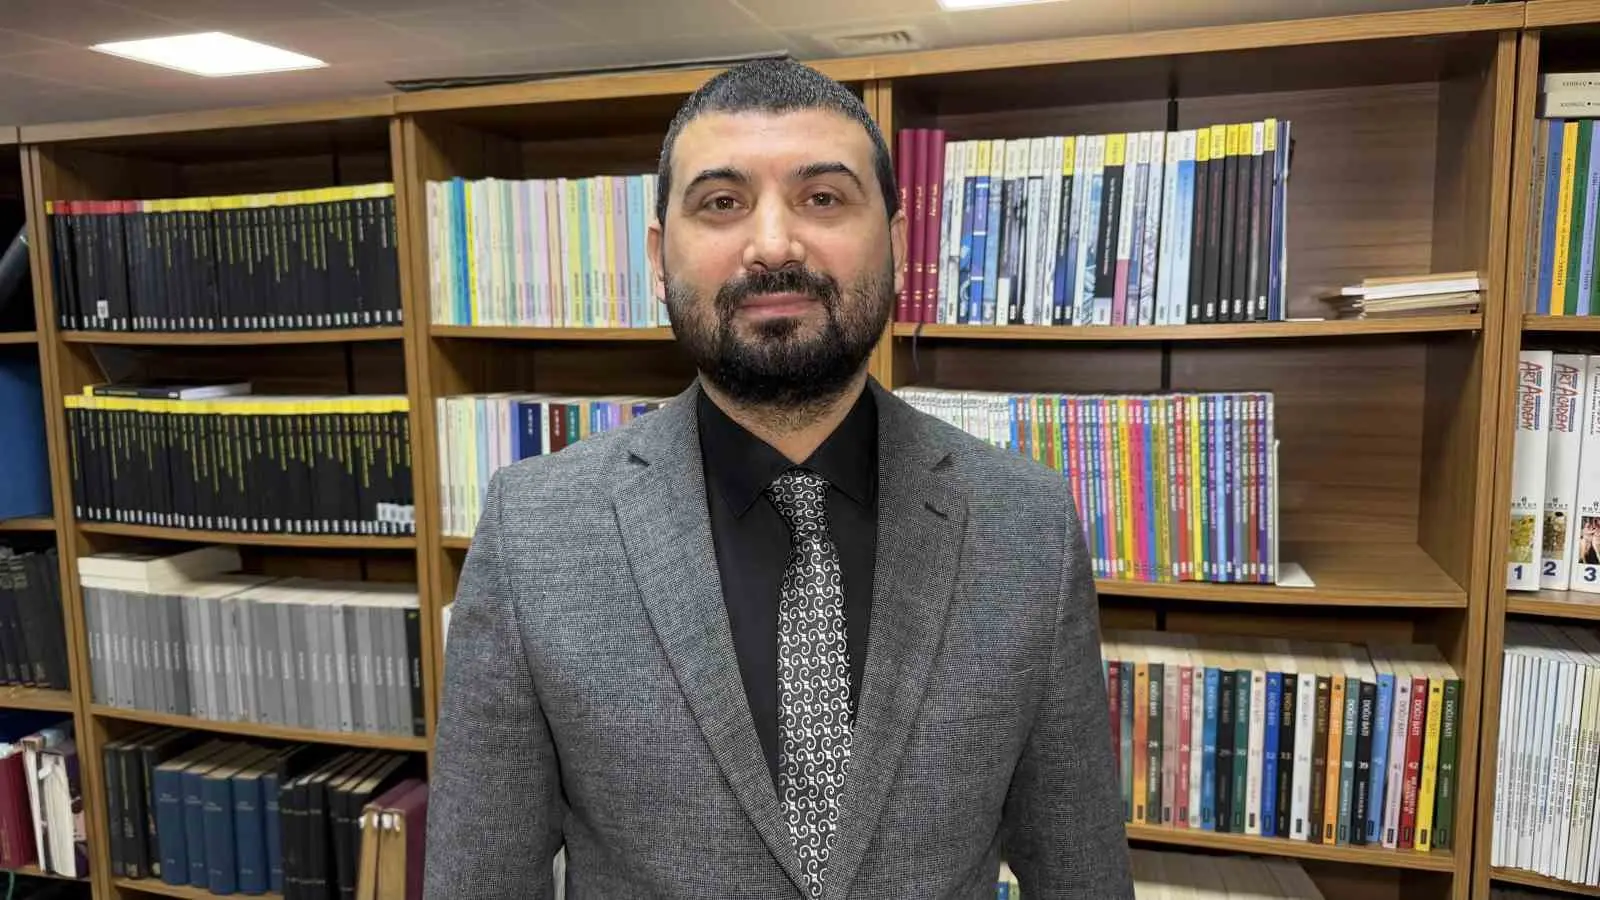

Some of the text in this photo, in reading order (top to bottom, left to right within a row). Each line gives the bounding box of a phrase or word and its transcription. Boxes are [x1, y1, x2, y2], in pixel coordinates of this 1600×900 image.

[1518, 361, 1544, 431] ART ACADEMY
[1553, 364, 1580, 432] ART ACADEMY
[1514, 564, 1523, 580] 1
[1543, 561, 1557, 576] 2
[1584, 566, 1597, 582] 3
